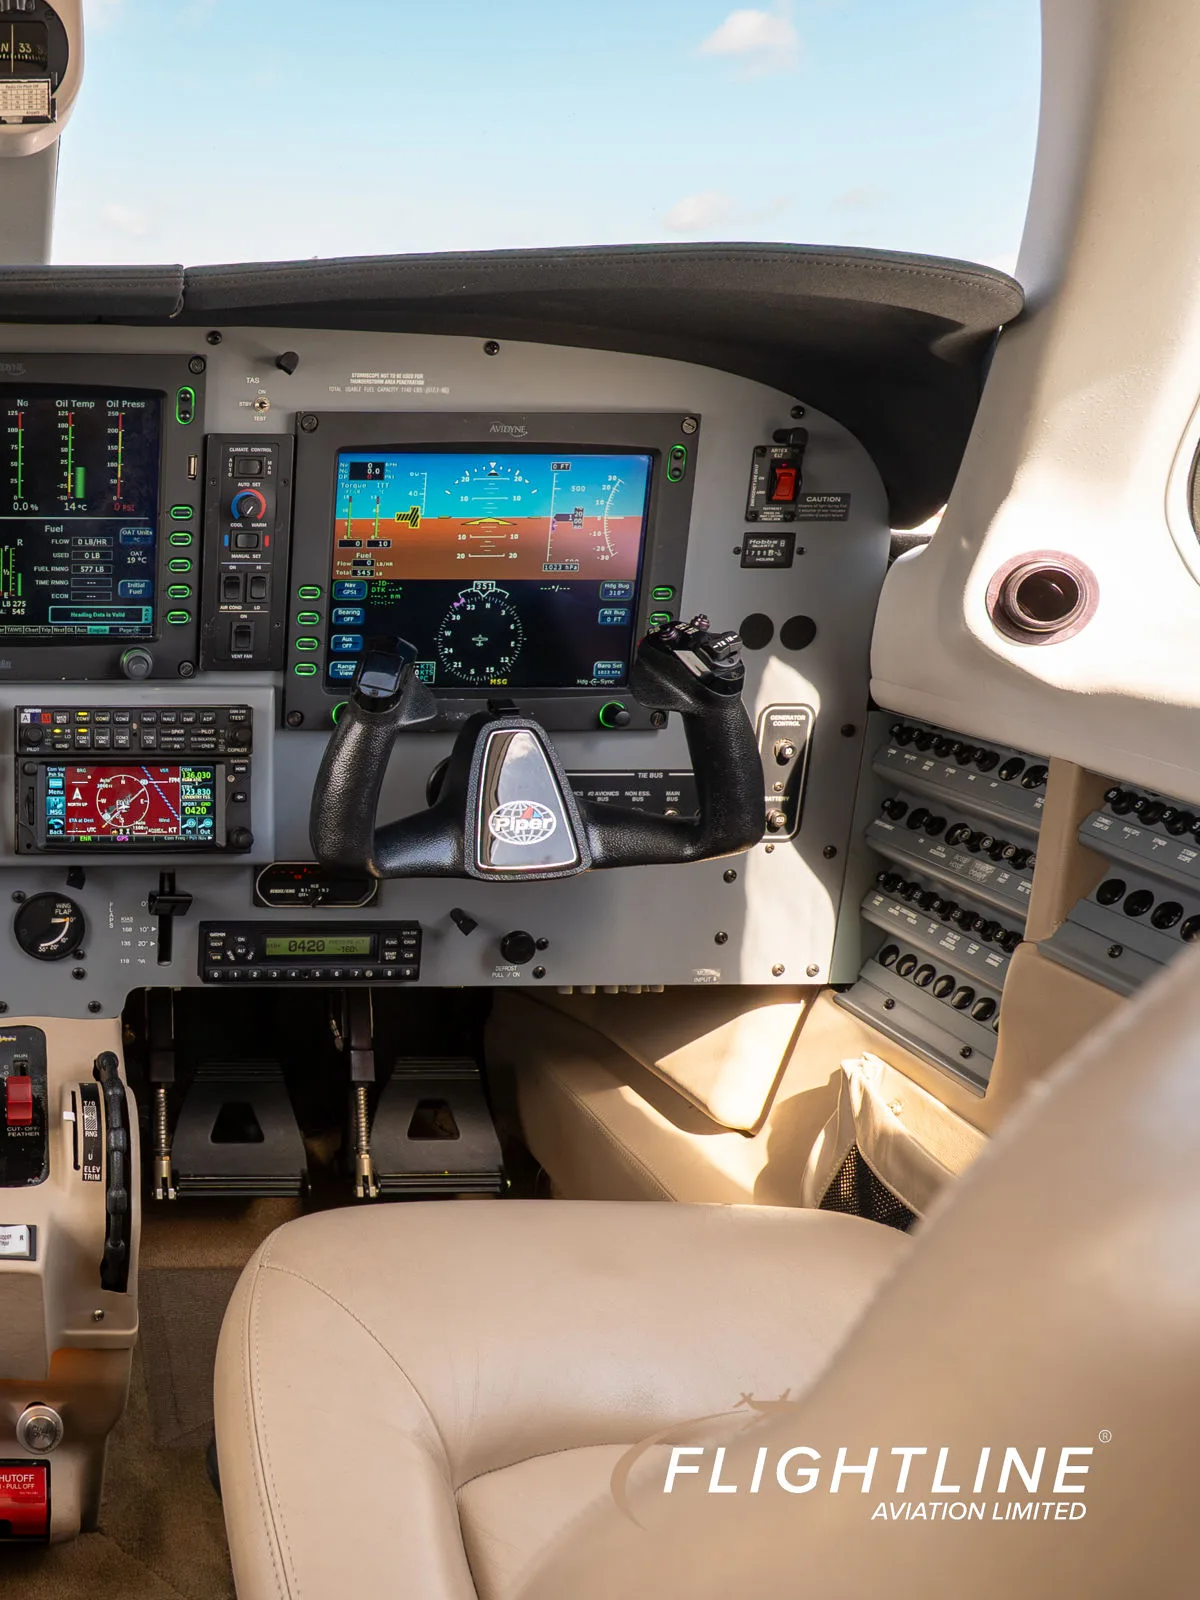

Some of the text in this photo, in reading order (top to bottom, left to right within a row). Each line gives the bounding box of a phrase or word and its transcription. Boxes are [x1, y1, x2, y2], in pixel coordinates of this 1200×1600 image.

[1, 43, 9, 53] N
[19, 43, 32, 53] 33
[71, 400, 95, 409] Temp
[489, 424, 526, 433] AVIDYNE
[13, 502, 28, 510] 0.0
[45, 525, 64, 533] Fuel
[495, 817, 552, 833] Piper
[288, 940, 325, 952] 0420
